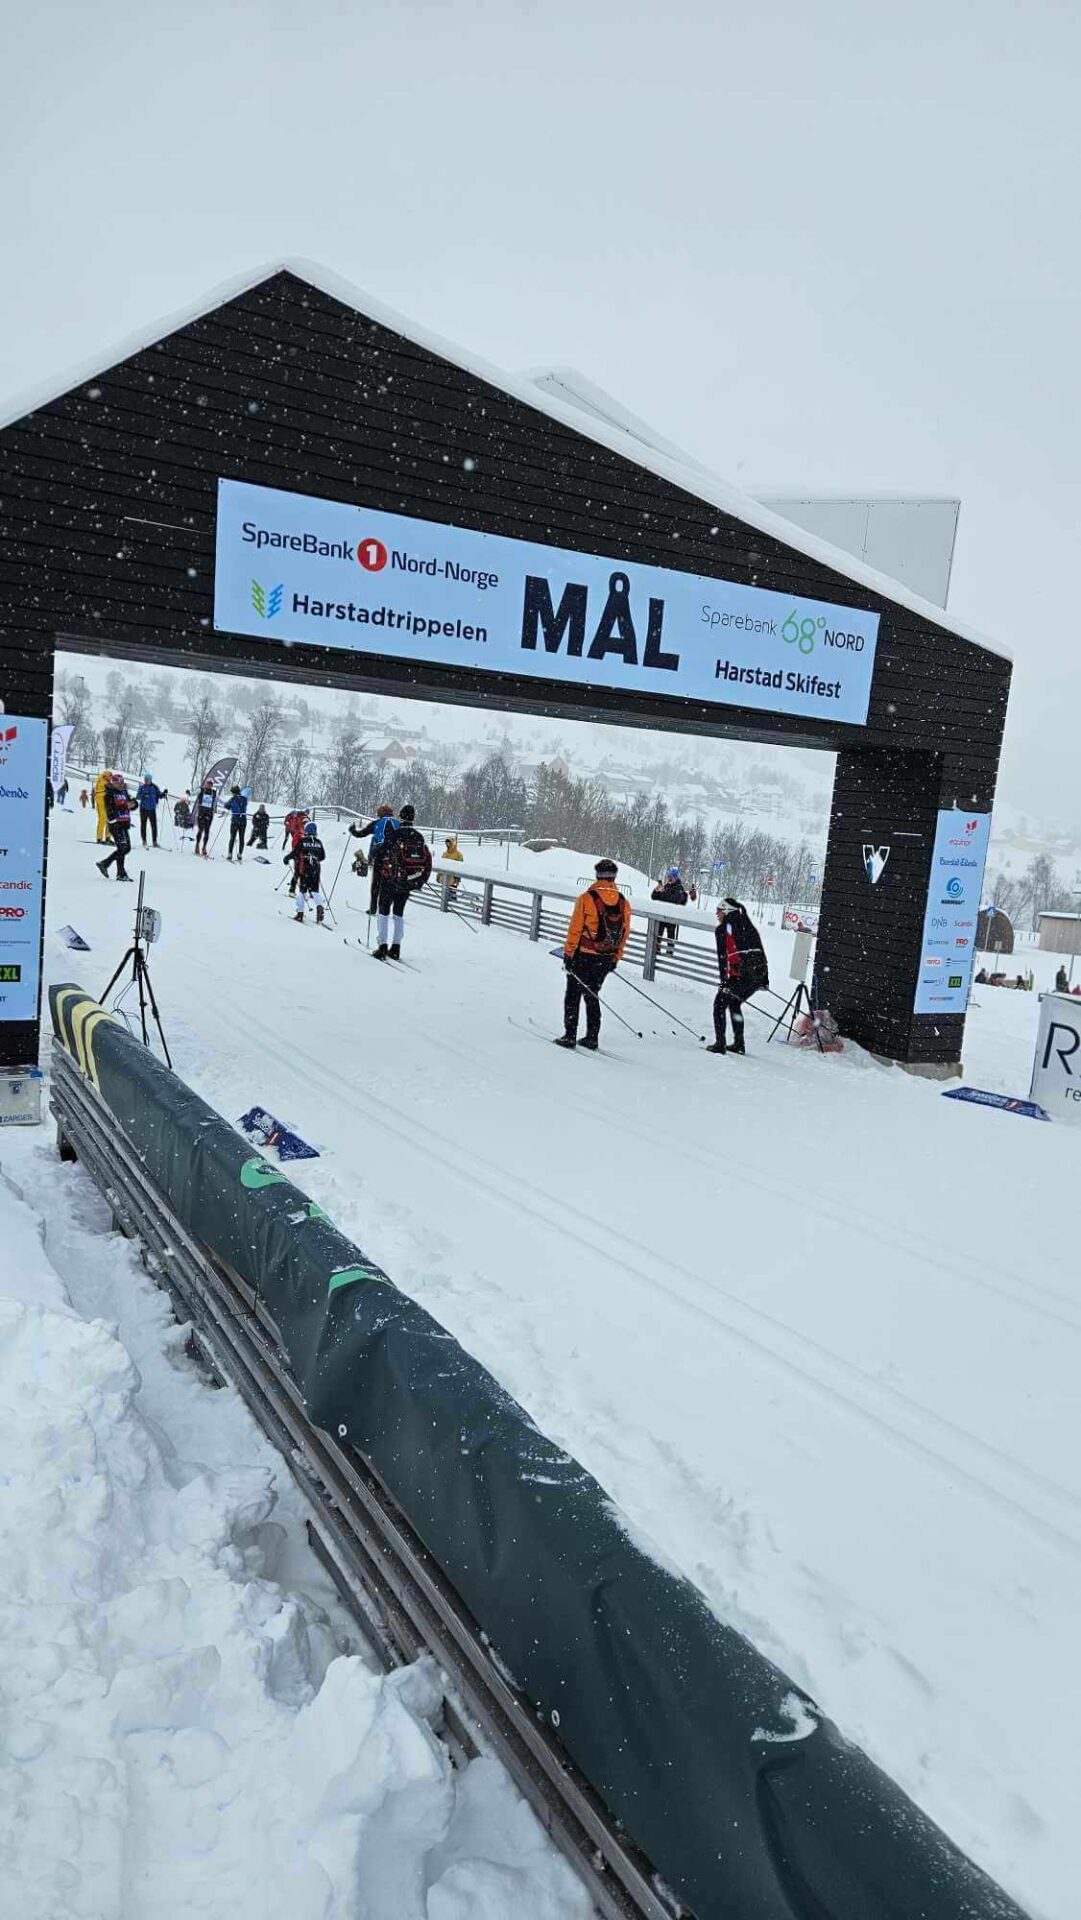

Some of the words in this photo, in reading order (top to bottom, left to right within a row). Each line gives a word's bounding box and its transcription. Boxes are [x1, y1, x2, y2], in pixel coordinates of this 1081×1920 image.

[241, 522, 354, 561] SpareBank
[391, 551, 499, 589] Nord-Norge
[292, 593, 488, 642] Harstadtrippelen
[520, 572, 680, 671] MÅL
[700, 605, 778, 636] Sparebank
[823, 629, 866, 652] NORD
[714, 659, 783, 688] Harstad
[785, 672, 842, 699] Skifest
